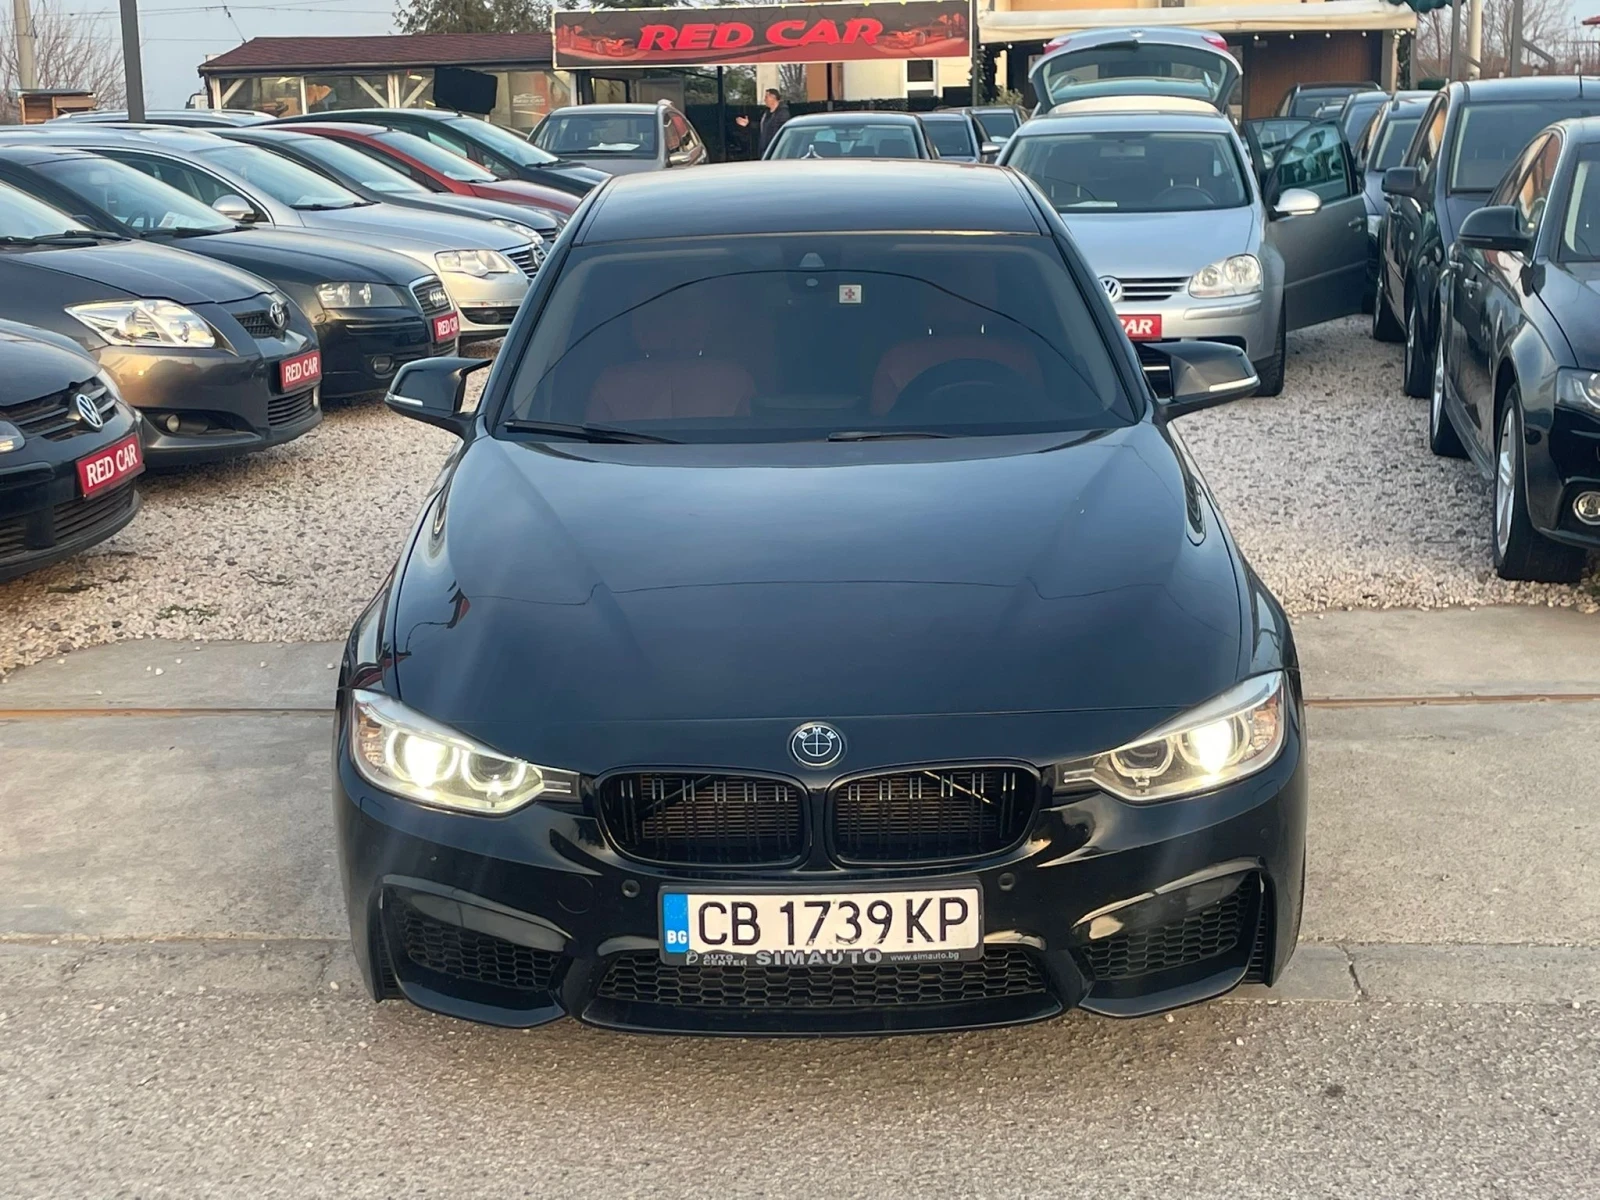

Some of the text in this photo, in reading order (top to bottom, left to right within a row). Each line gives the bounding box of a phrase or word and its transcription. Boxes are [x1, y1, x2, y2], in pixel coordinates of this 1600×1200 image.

[637, 17, 883, 50] RED CAR
[285, 356, 318, 383] RED CAR
[86, 443, 138, 488] RED CAR
[698, 896, 969, 946] CB 1739 KP
[666, 930, 687, 944] BG
[756, 949, 882, 966] SIMAUTO
[890, 951, 960, 962] www.simauto.bg
